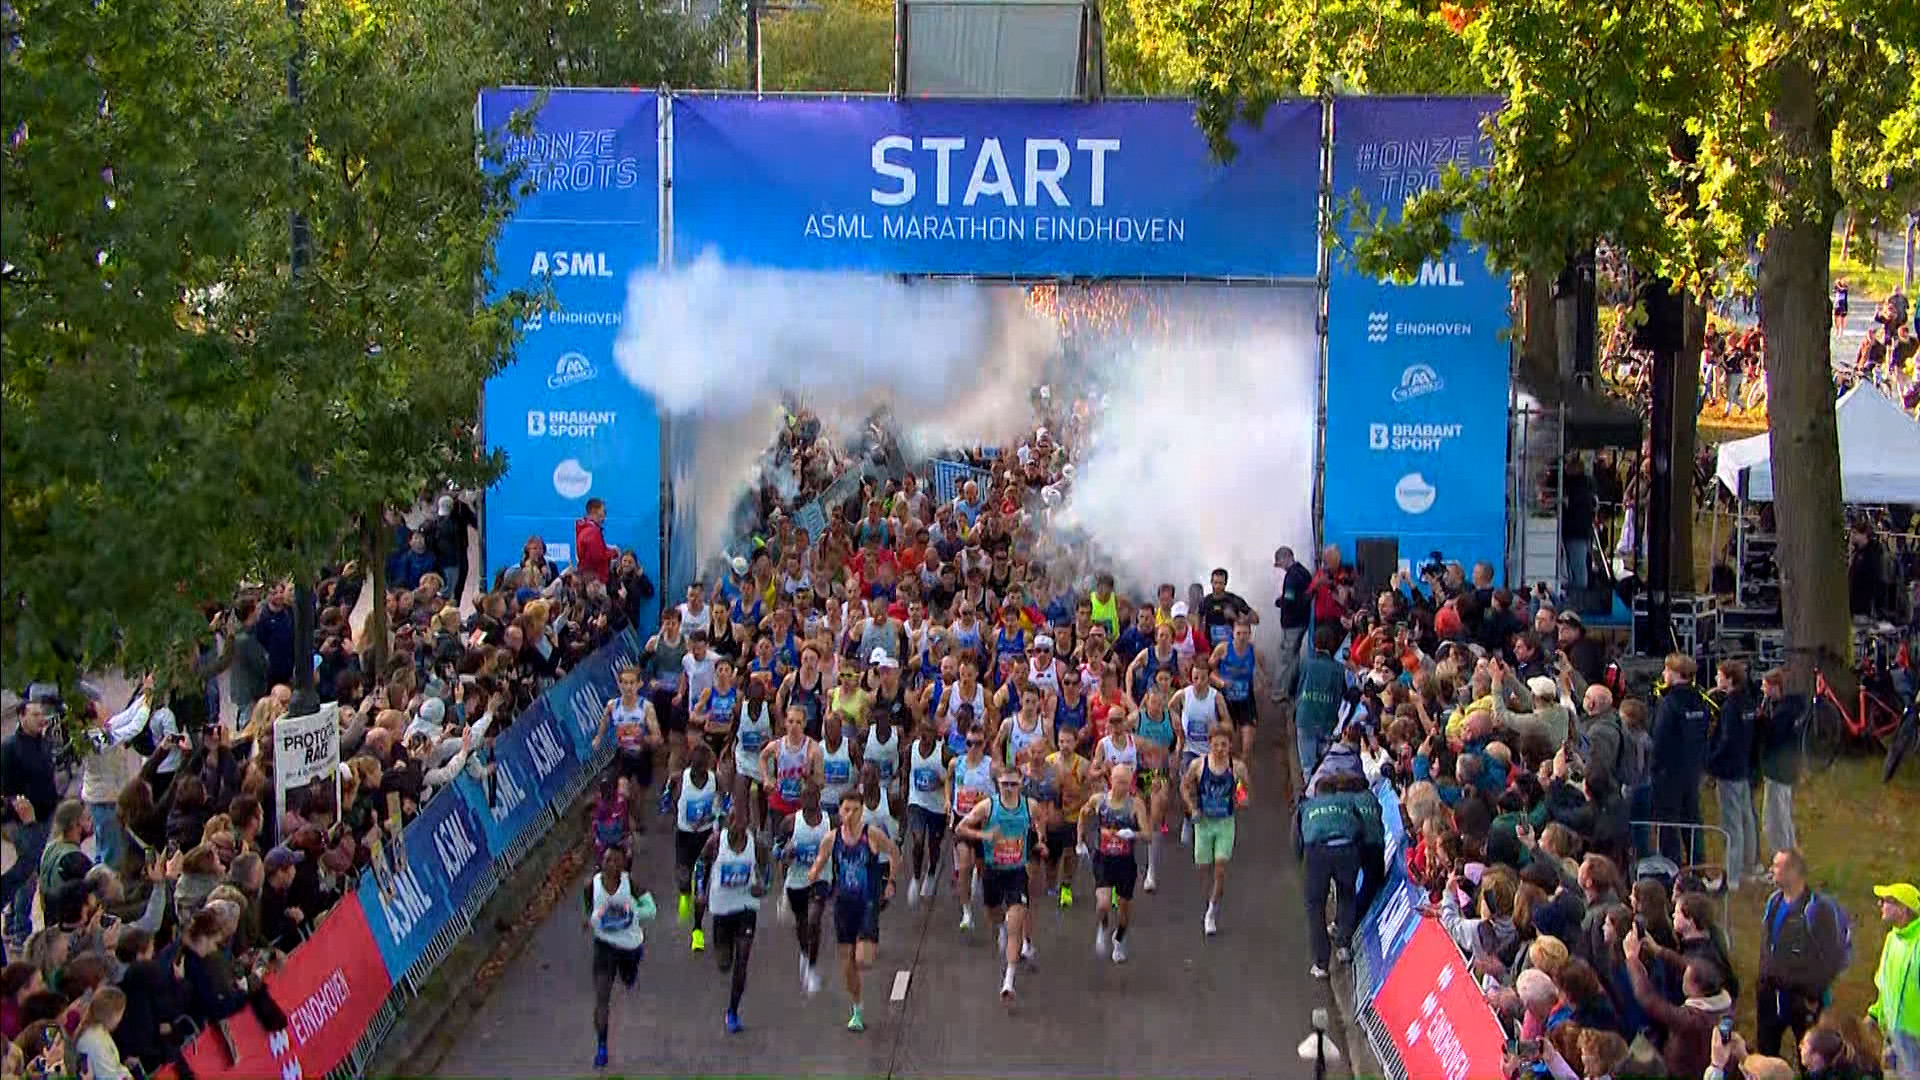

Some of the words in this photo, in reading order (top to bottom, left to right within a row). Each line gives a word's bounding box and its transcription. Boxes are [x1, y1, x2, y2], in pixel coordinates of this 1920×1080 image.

[1358, 135, 1474, 171] #ONZE
[528, 157, 638, 192] TROTS
[871, 135, 1121, 207] START
[804, 213, 873, 239] ASML
[883, 214, 1025, 241] MARATHON
[1035, 216, 1185, 242] EINDHOVEN
[530, 251, 614, 276] ASML
[549, 311, 622, 325] EINDHOVEN
[1395, 322, 1472, 336] EINDHOVEN
[549, 411, 617, 424] BRABANT
[1392, 424, 1463, 437] BRABANT
[549, 425, 598, 438] SPORT
[1391, 437, 1442, 450] SPORT
[525, 719, 566, 782] ASML
[433, 808, 477, 883] ASML
[378, 862, 433, 946] ASML
